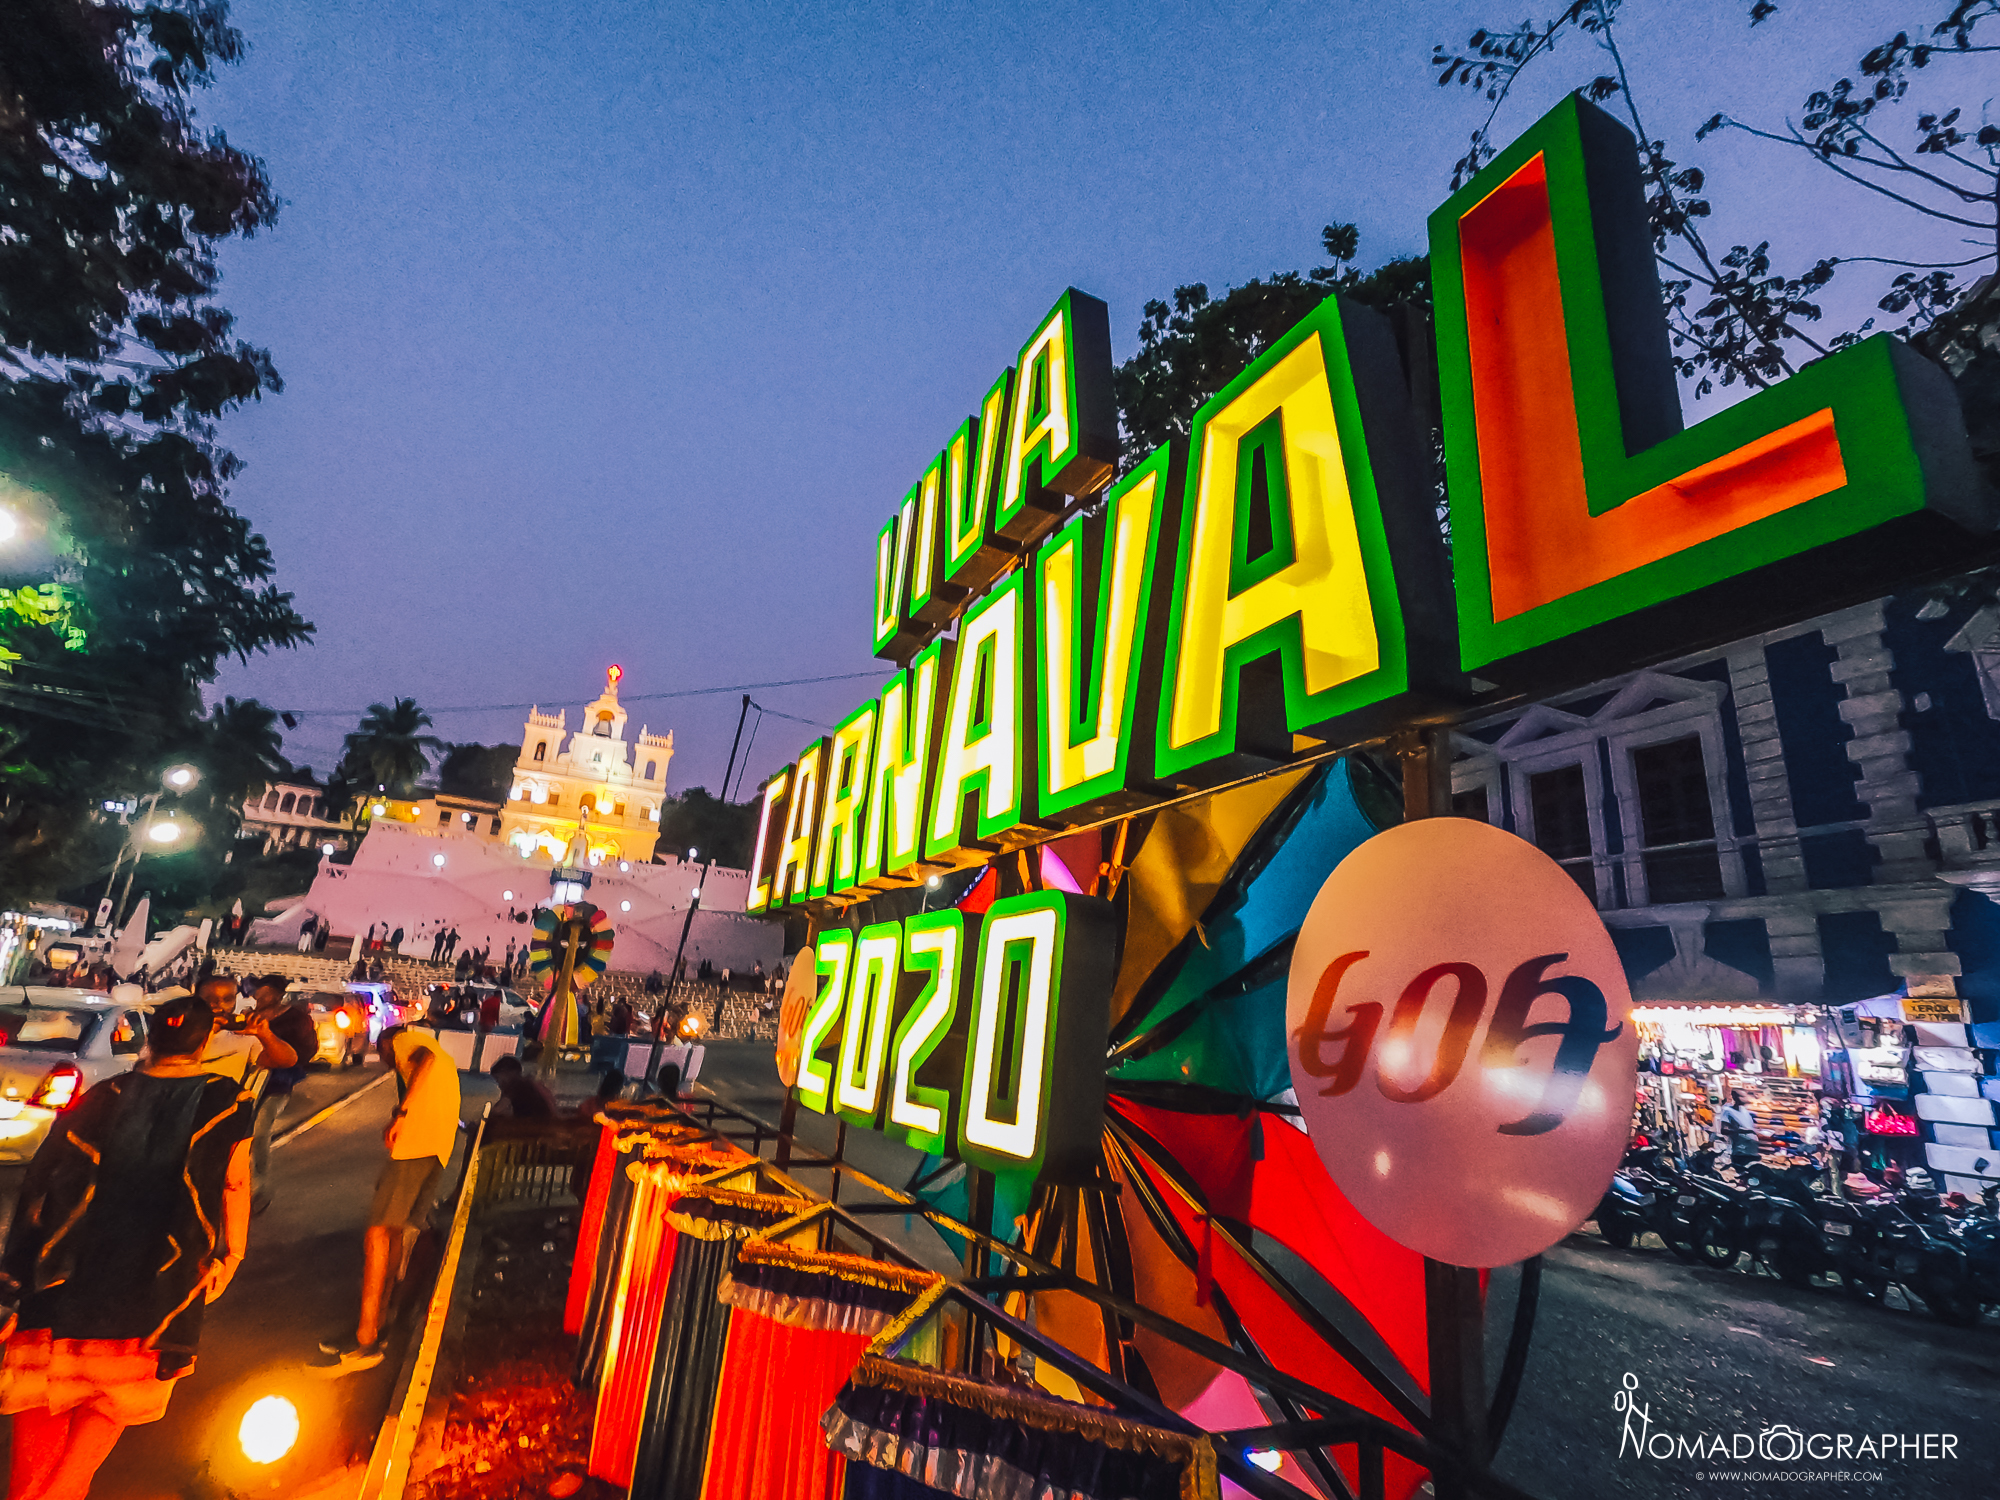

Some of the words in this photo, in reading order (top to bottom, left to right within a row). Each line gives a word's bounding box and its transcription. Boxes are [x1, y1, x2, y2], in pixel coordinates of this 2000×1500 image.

[747, 91, 1927, 914] CARNAVAL
[873, 287, 1079, 658] VIVA
[796, 890, 1066, 1174] 2020
